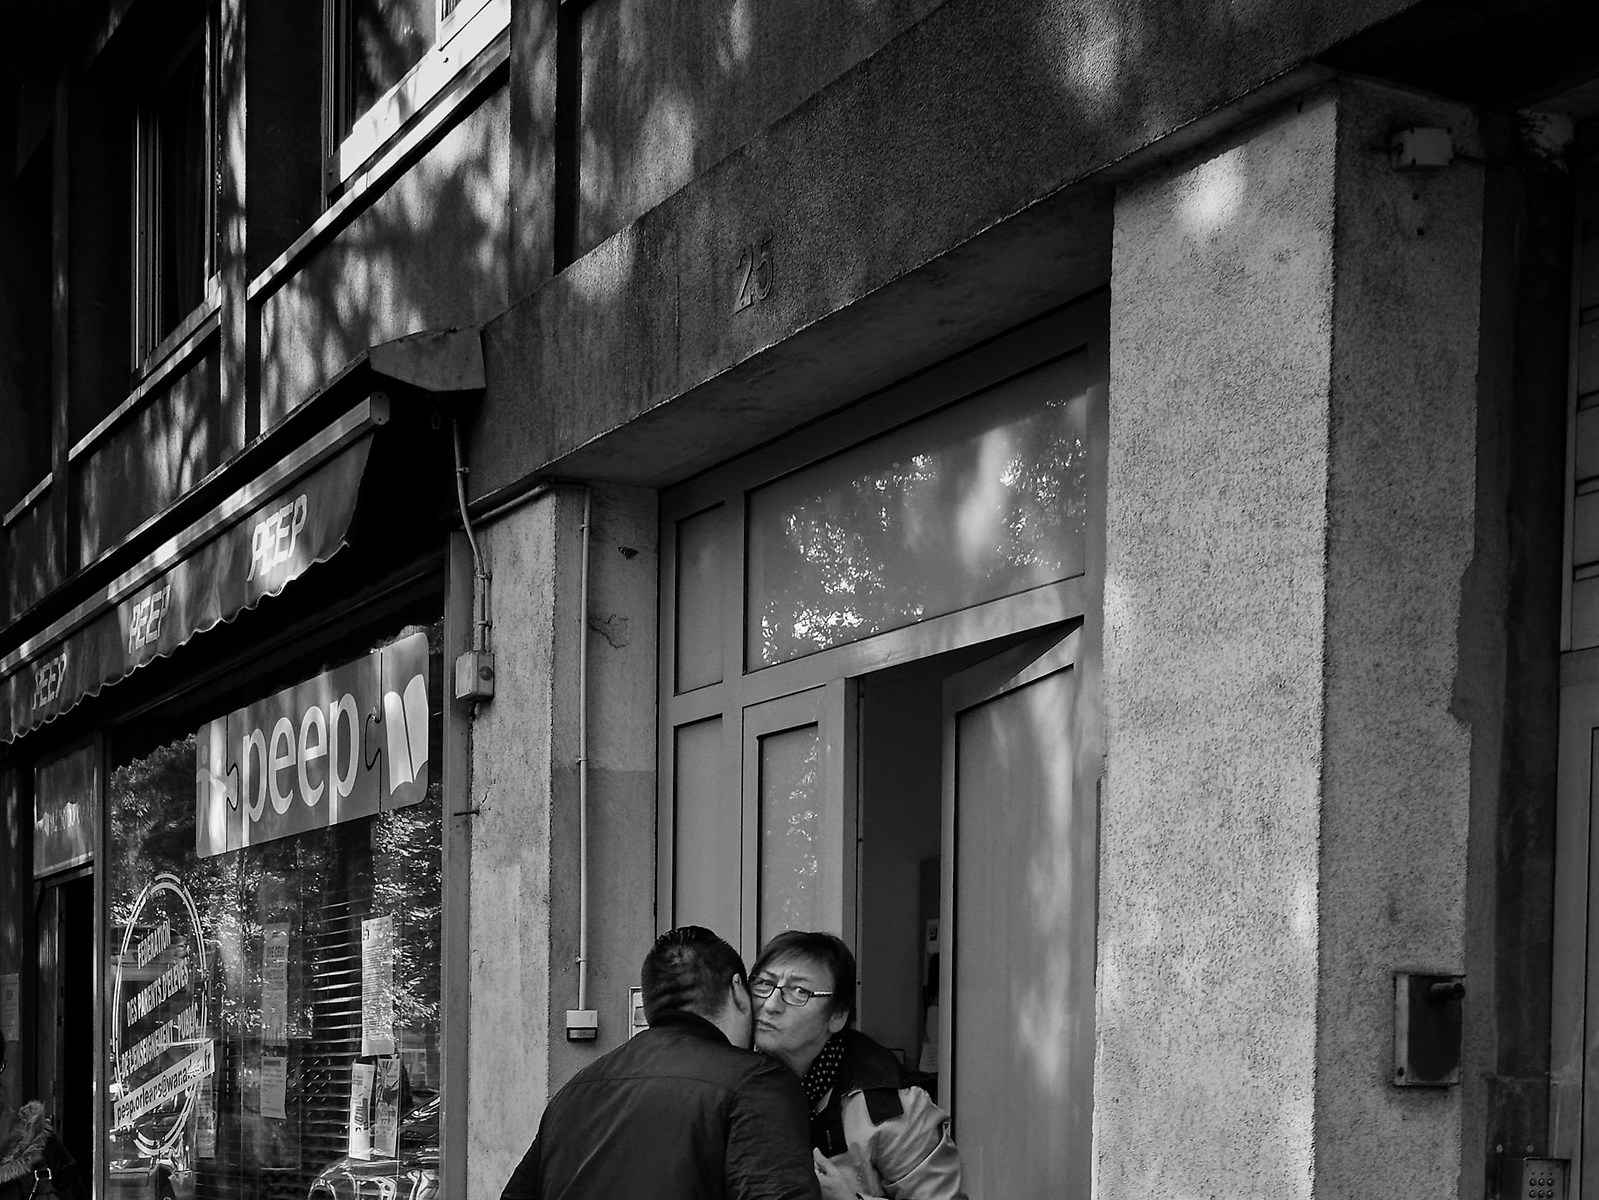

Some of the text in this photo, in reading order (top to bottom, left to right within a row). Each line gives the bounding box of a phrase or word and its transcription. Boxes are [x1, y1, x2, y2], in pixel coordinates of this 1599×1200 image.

[733, 231, 774, 314] 25
[247, 494, 308, 581] PEEP
[128, 584, 171, 654] PEEP
[32, 653, 67, 710] PEEP
[242, 693, 360, 848] peep
